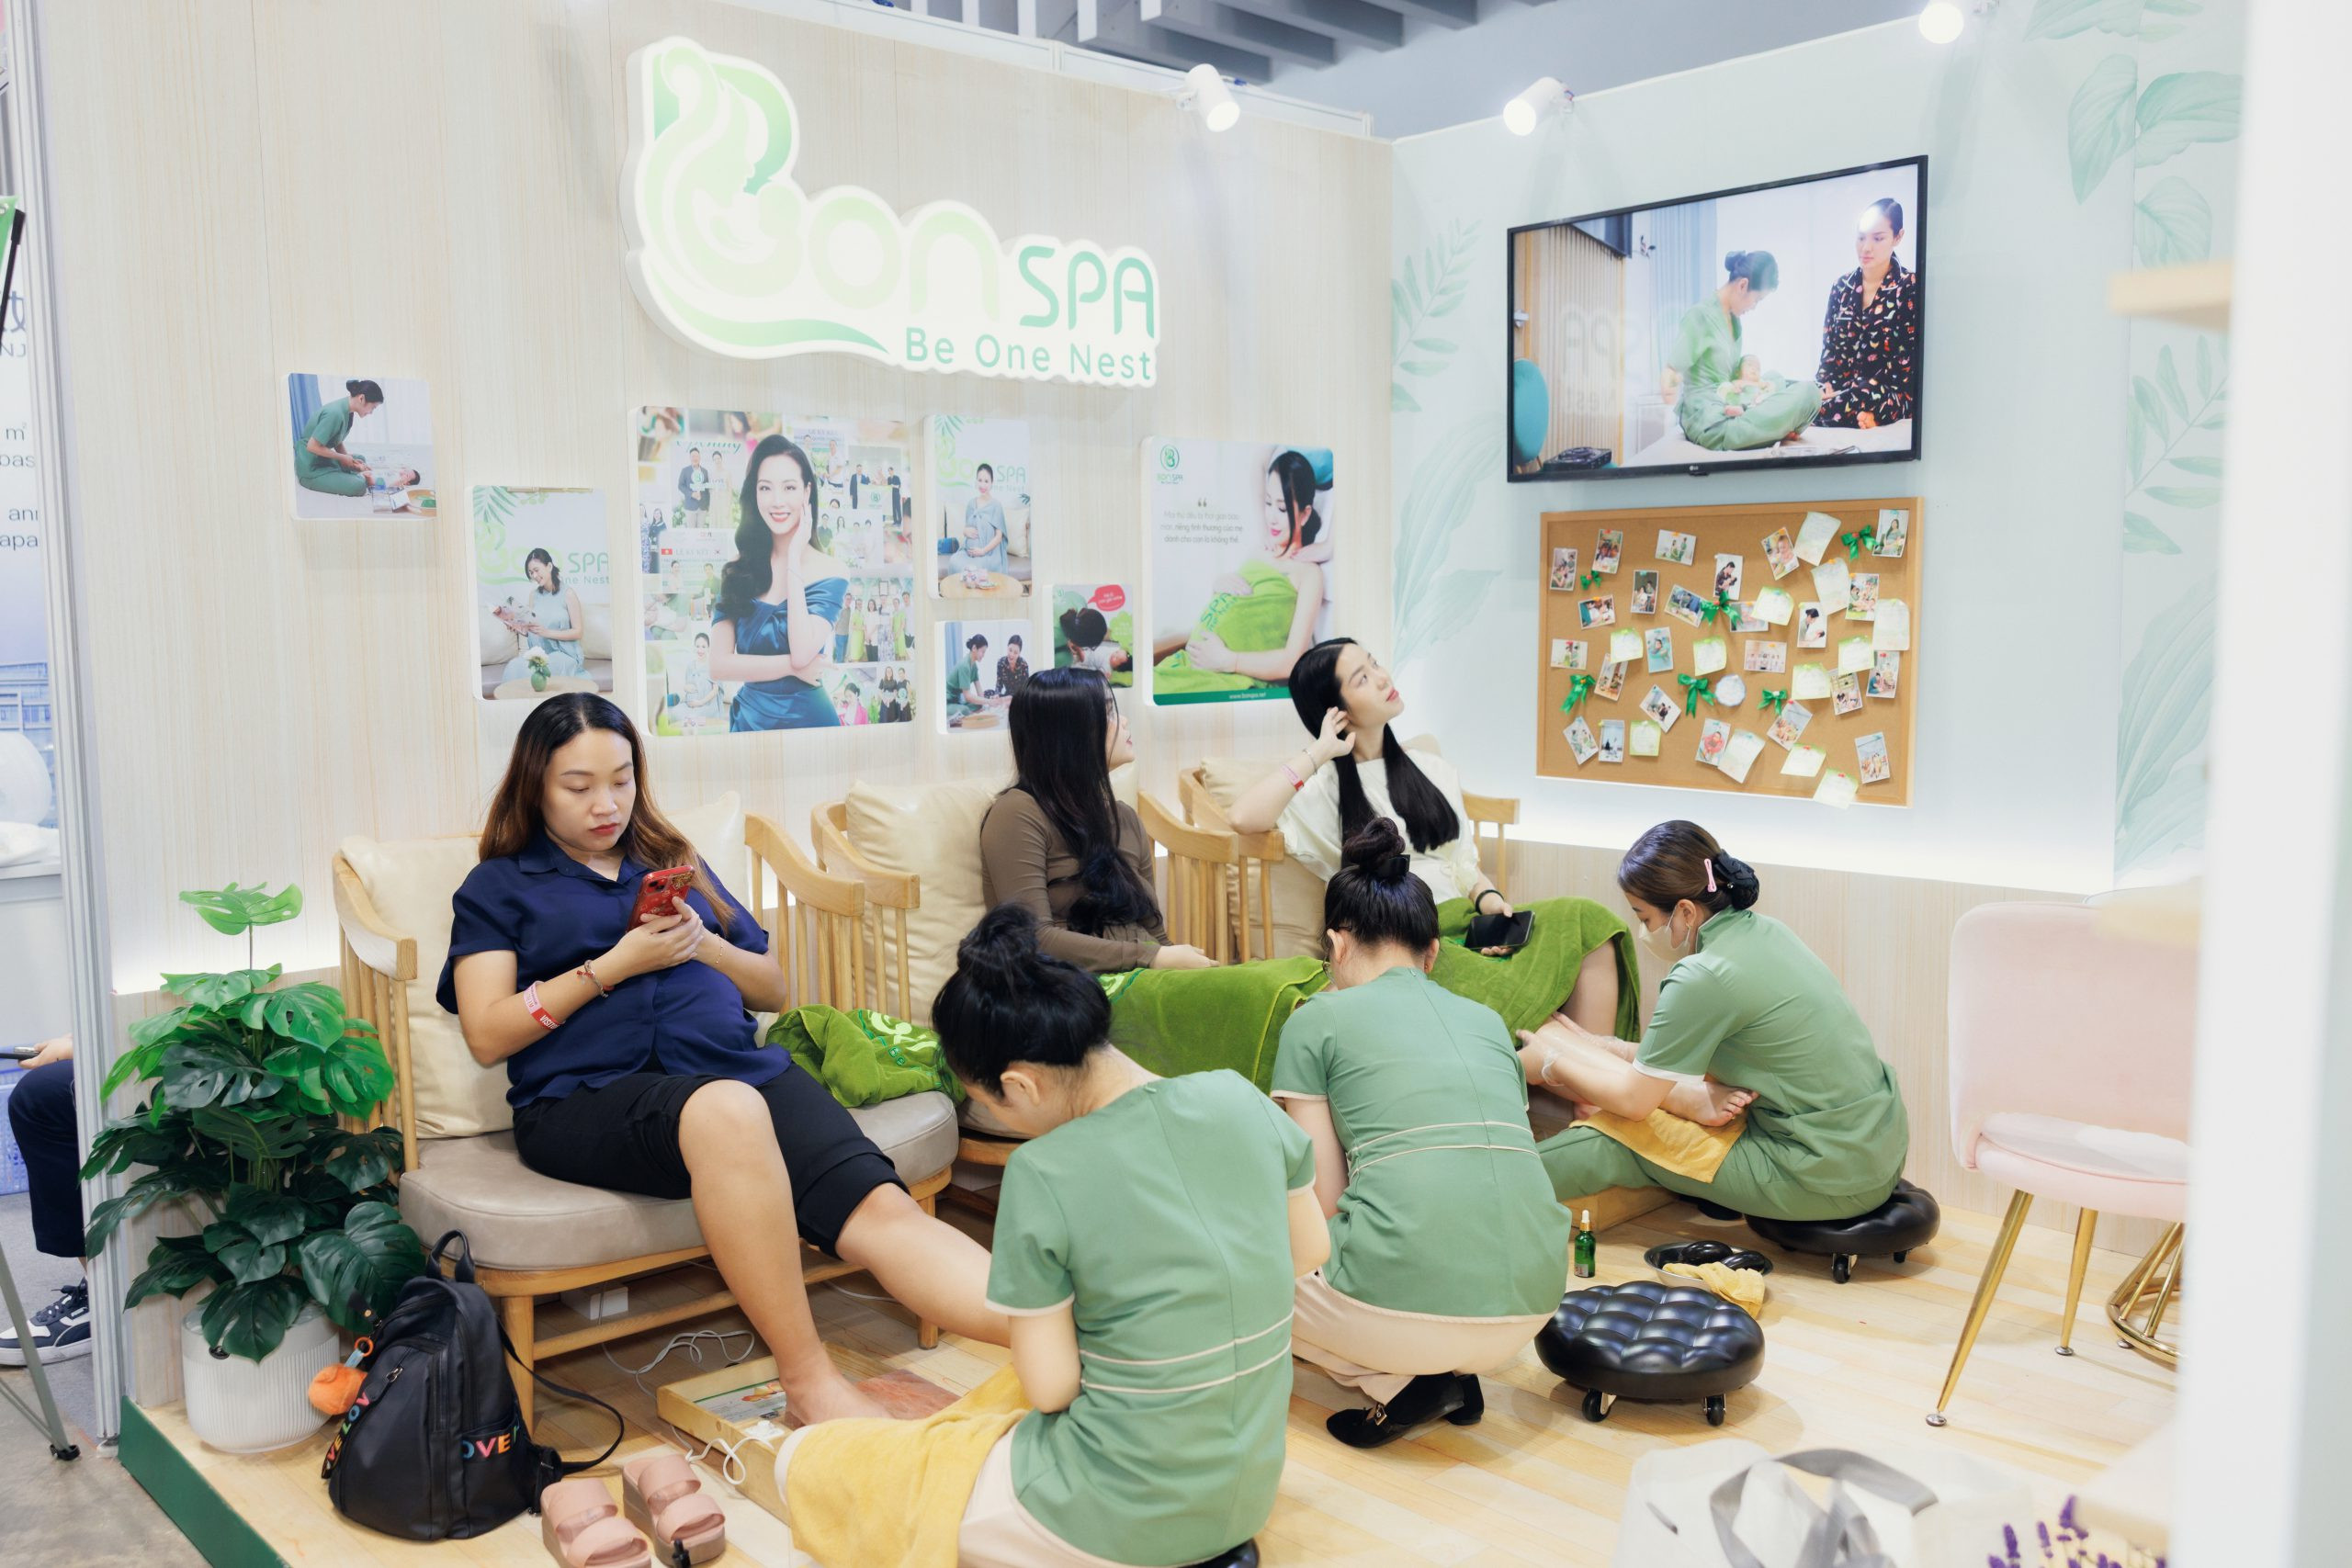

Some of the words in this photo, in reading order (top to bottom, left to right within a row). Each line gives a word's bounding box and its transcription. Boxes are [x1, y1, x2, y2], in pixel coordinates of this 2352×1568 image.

[1018, 244, 1156, 339] SPA
[905, 326, 955, 366] Be
[975, 333, 1051, 374] One
[1069, 343, 1152, 381] Nest
[996, 465, 1026, 484] SPA
[567, 552, 609, 574] SPA
[583, 576, 610, 585] Nest
